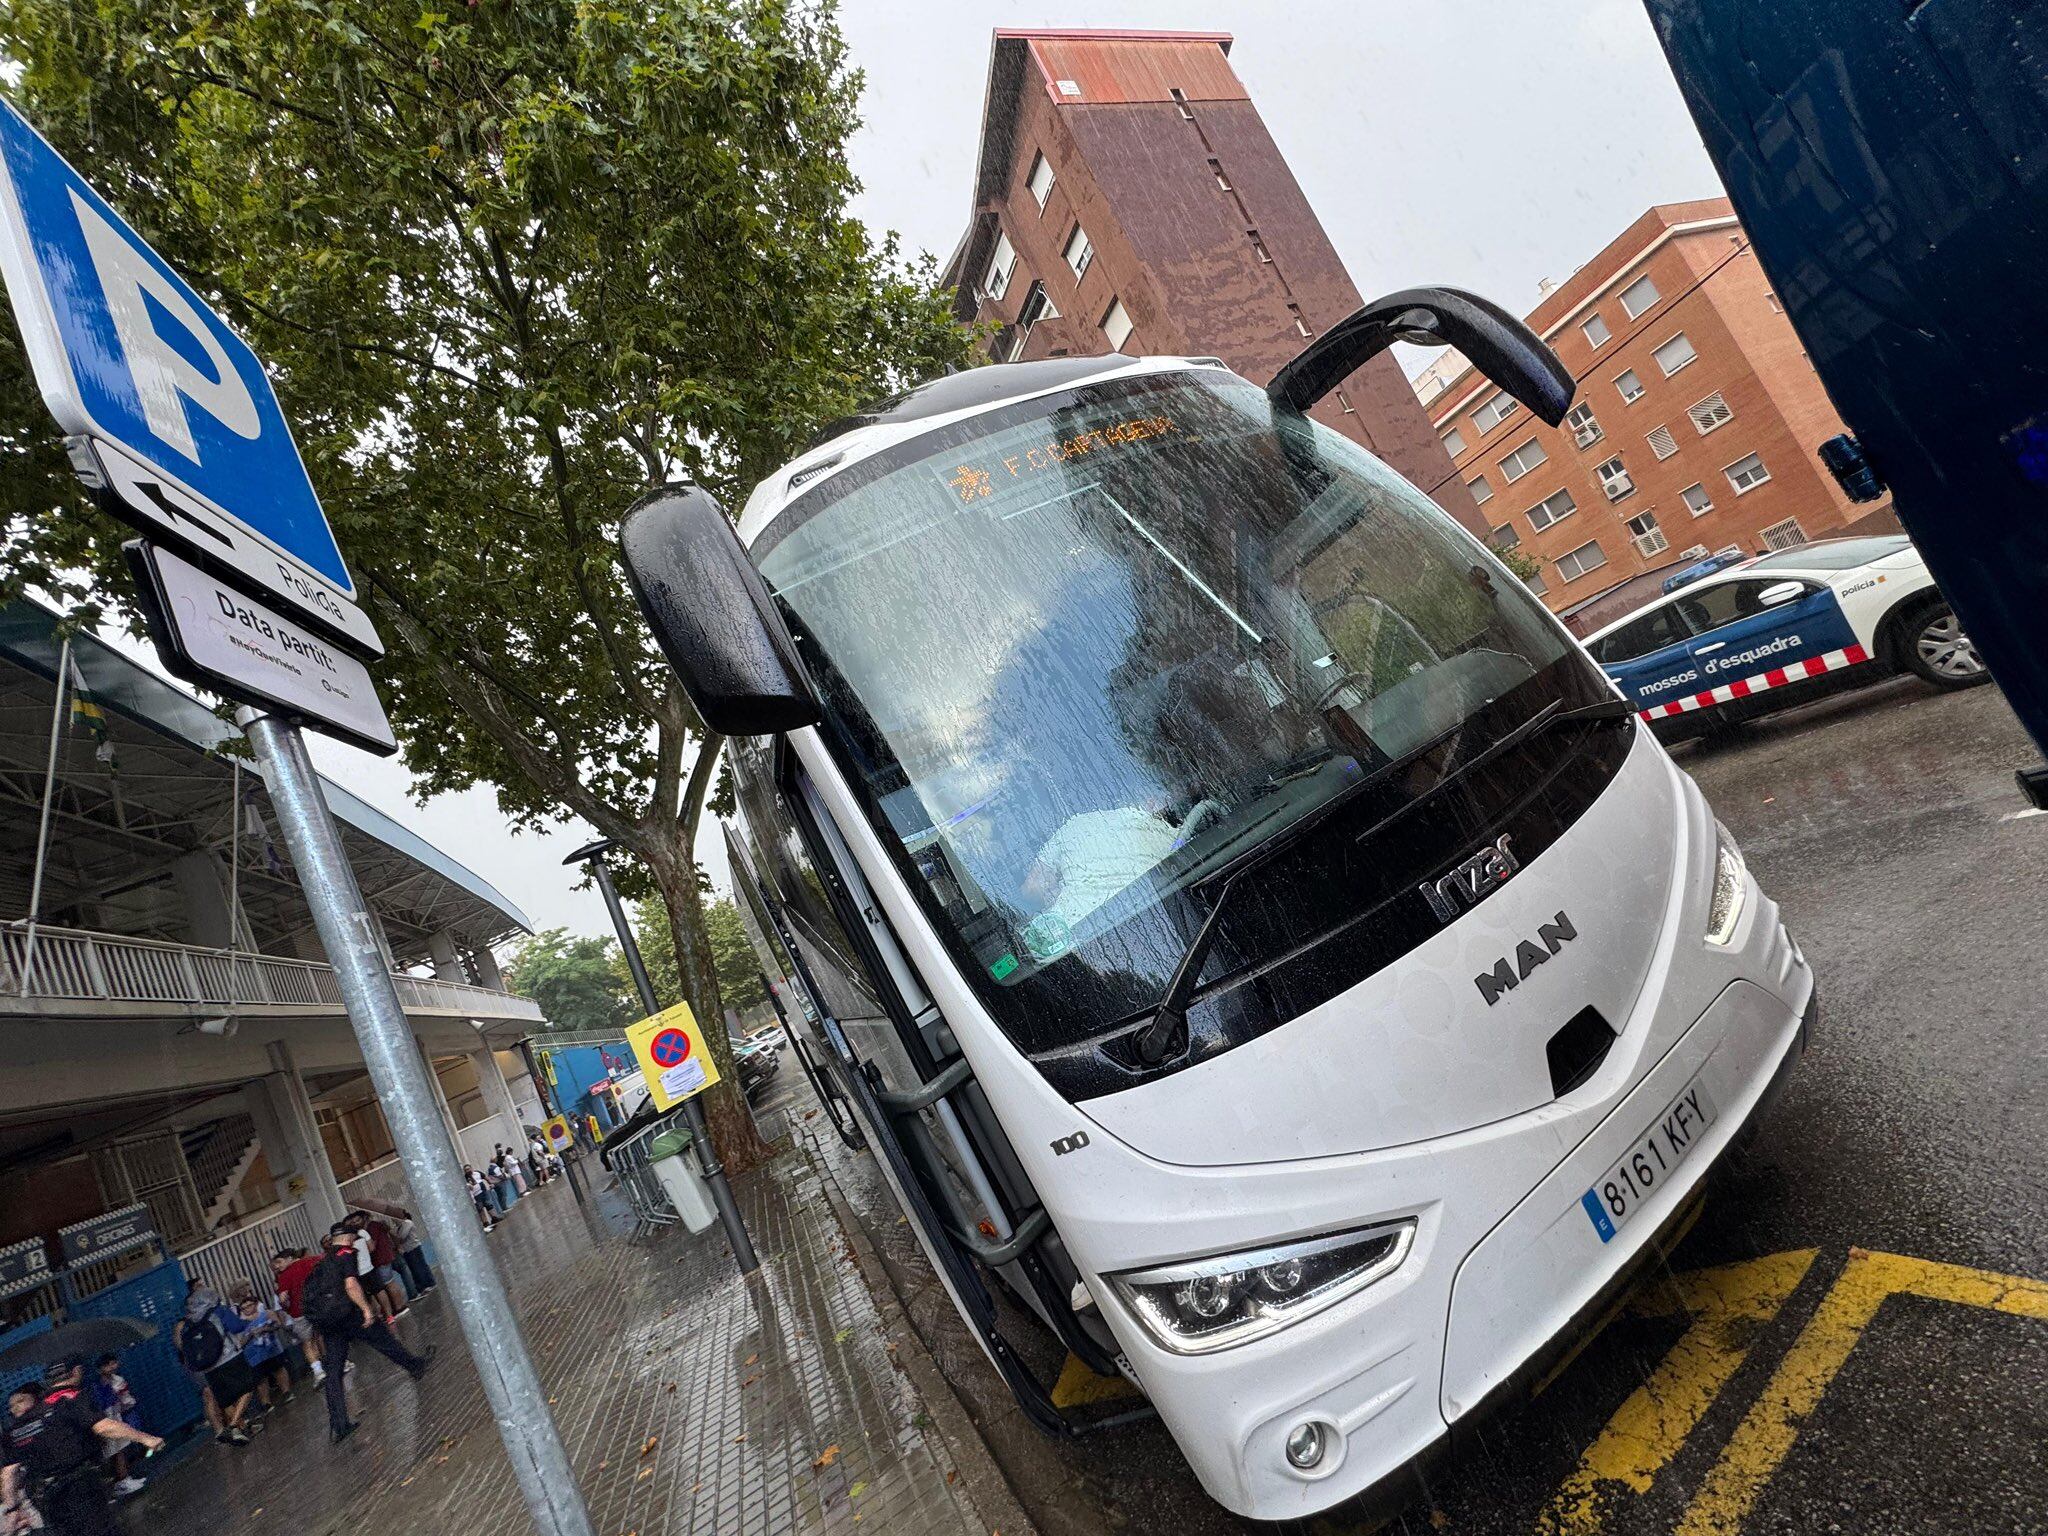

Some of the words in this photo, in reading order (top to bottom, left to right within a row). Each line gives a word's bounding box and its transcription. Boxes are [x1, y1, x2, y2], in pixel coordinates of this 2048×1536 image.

[66, 183, 261, 468] P
[215, 590, 275, 640] Data
[278, 628, 337, 674] partit:
[276, 562, 346, 622] Policia
[1638, 668, 1698, 697] mossos
[1705, 633, 1802, 674] d'esquadra
[1474, 910, 1578, 1006] MAN
[1050, 1130, 1090, 1156] 100
[1604, 1138, 1667, 1217] 8161
[1661, 1088, 1705, 1155] KFY
